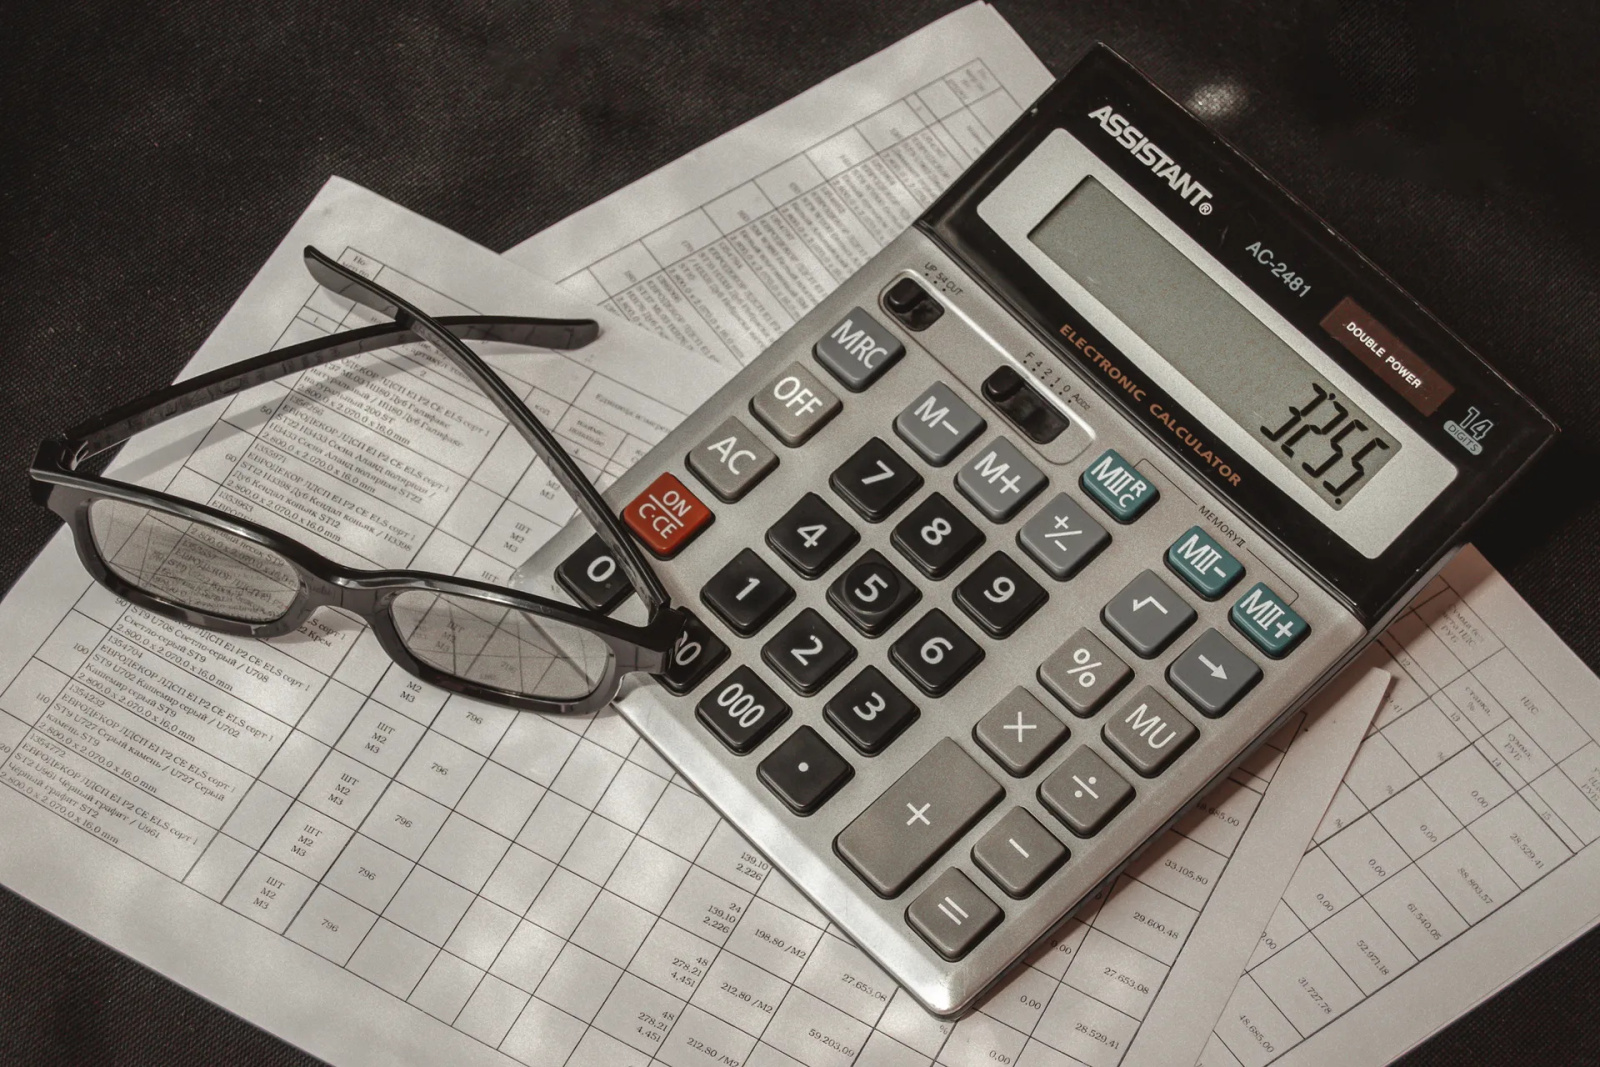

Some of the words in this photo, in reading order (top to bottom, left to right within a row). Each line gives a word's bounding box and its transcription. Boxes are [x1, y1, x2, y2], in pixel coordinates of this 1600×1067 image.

[1245, 241, 1311, 297] AC-2481
[831, 318, 888, 370] MRC
[1346, 321, 1386, 357] DOUBLE
[1385, 355, 1422, 388] POWER
[774, 376, 823, 416] OFF
[1059, 324, 1146, 402] ELECTRONIC
[1150, 404, 1241, 487] CALCULATOR
[1459, 406, 1494, 441] 14
[1446, 423, 1479, 453] DIGITS
[225, 453, 237, 463] 60
[707, 436, 756, 475] AC
[861, 460, 895, 485] 7
[974, 451, 1021, 494] M+
[232, 470, 251, 483] Дуб
[251, 479, 284, 501] Кендал
[285, 498, 318, 518] коньяк
[663, 490, 691, 516] ON
[797, 524, 827, 548] 4
[921, 517, 952, 545] 8
[587, 556, 616, 582] 0
[736, 577, 760, 601] 1
[854, 573, 888, 602] 5
[983, 576, 1015, 603] 9
[73, 643, 89, 655] 100
[107, 635, 143, 659] 1354704
[186, 649, 207, 663] ST9
[790, 635, 823, 666] 2
[920, 637, 953, 664] 6
[36, 692, 51, 704] 110
[69, 684, 106, 708] 1354232
[85, 663, 128, 691] Кашемир
[128, 688, 157, 707] серый
[157, 703, 177, 718] ST9
[92, 653, 113, 667] ST9
[112, 664, 137, 682] U702
[136, 678, 179, 706] Кашемир
[179, 703, 208, 721] серый
[216, 721, 240, 738] U702
[466, 711, 483, 725] 796
[717, 683, 765, 728] 000
[853, 692, 886, 721] 3
[80, 732, 100, 747] ST9
[1125, 703, 1176, 749] MU
[73, 714, 98, 730] U727
[97, 728, 128, 750] Серый
[128, 746, 161, 768] камень
[170, 768, 195, 784] U727
[194, 781, 225, 802] Серый
[431, 762, 449, 776] 796
[394, 814, 413, 828] 796
[358, 866, 376, 881] 796
[729, 903, 741, 913] 24
[321, 918, 339, 932] 796
[696, 957, 709, 966] 48
[662, 1011, 675, 1021] 48
